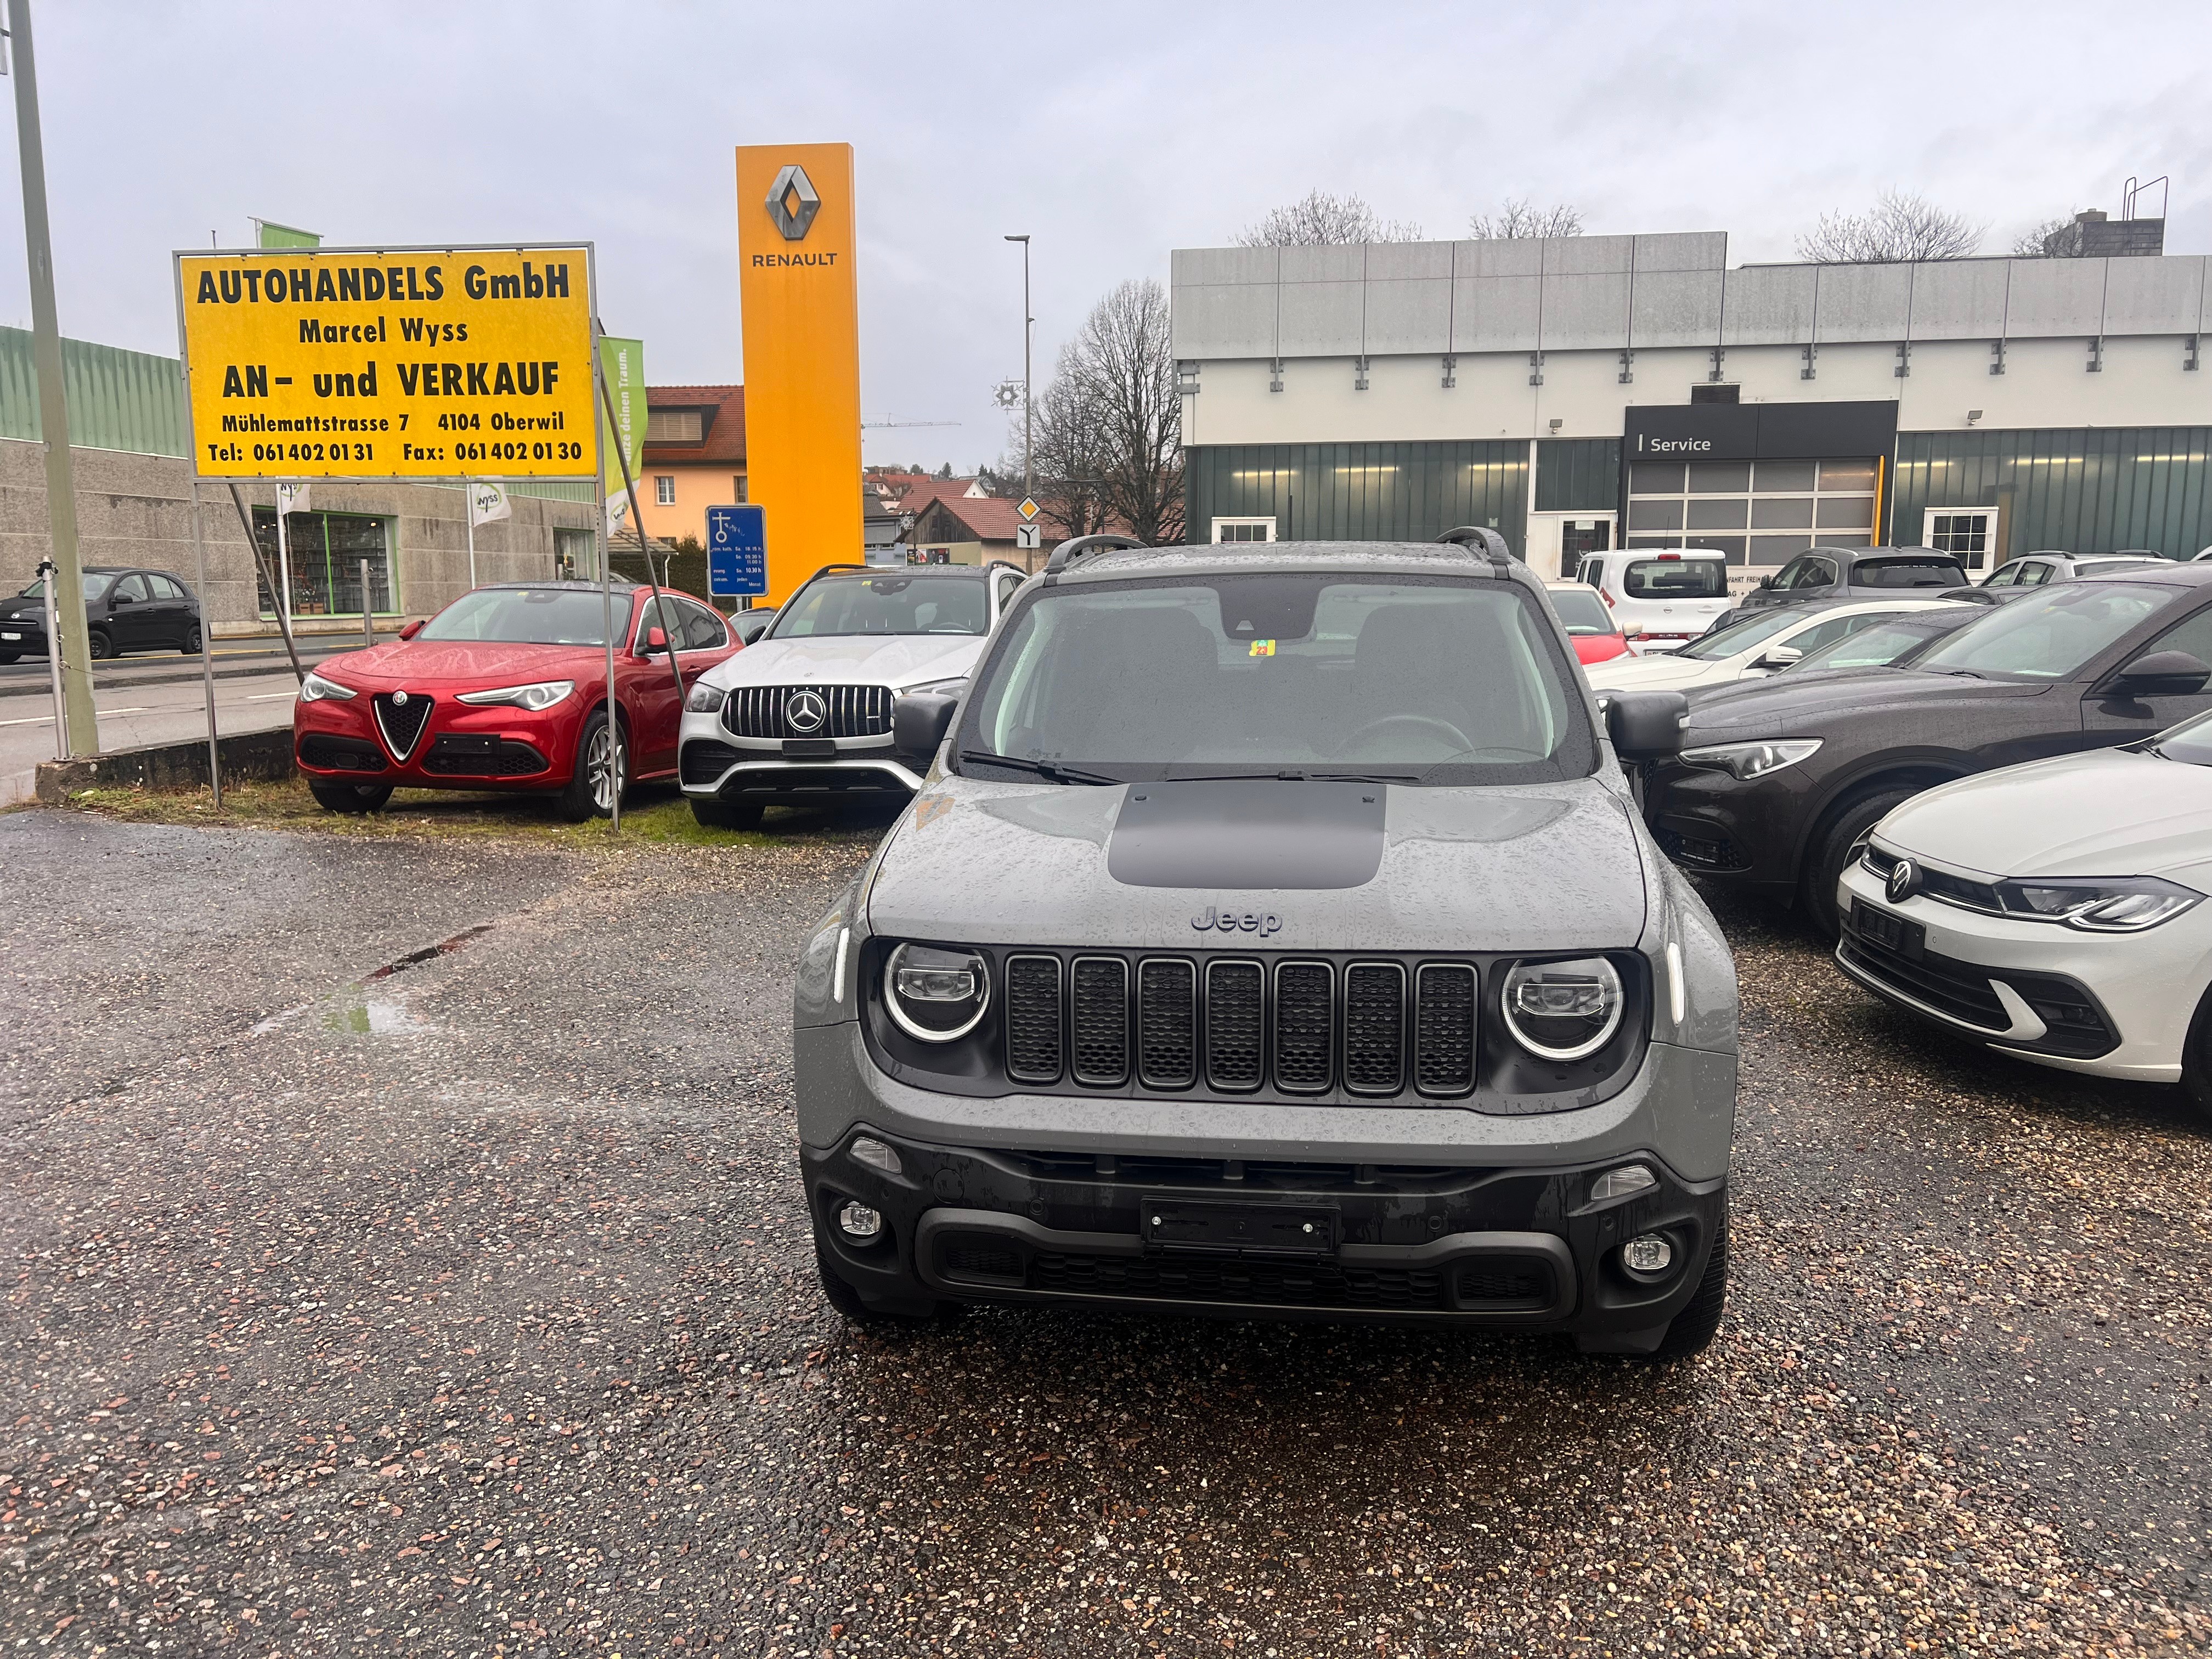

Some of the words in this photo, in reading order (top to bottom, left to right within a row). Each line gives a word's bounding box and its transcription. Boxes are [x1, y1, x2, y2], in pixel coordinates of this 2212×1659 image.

[752, 253, 837, 267] RENAULT
[198, 266, 444, 303] AUTOHANDELS
[465, 262, 569, 300] GmbH
[300, 317, 386, 343] Marcel
[399, 318, 468, 347] Wyss
[313, 362, 377, 397] und
[397, 362, 558, 396] VERKAUF
[618, 348, 628, 388] Traum.
[222, 414, 389, 432] Mühlemattstrasse
[399, 414, 409, 431] 7
[438, 414, 481, 431] 4104
[491, 411, 564, 430] Oberwil
[619, 392, 630, 431] deinen
[208, 443, 243, 461] Tel:
[403, 443, 444, 460] Fax:
[1651, 437, 1711, 452] Service
[1256, 646, 1268, 654] 23
[1191, 906, 1283, 938] Jeep
